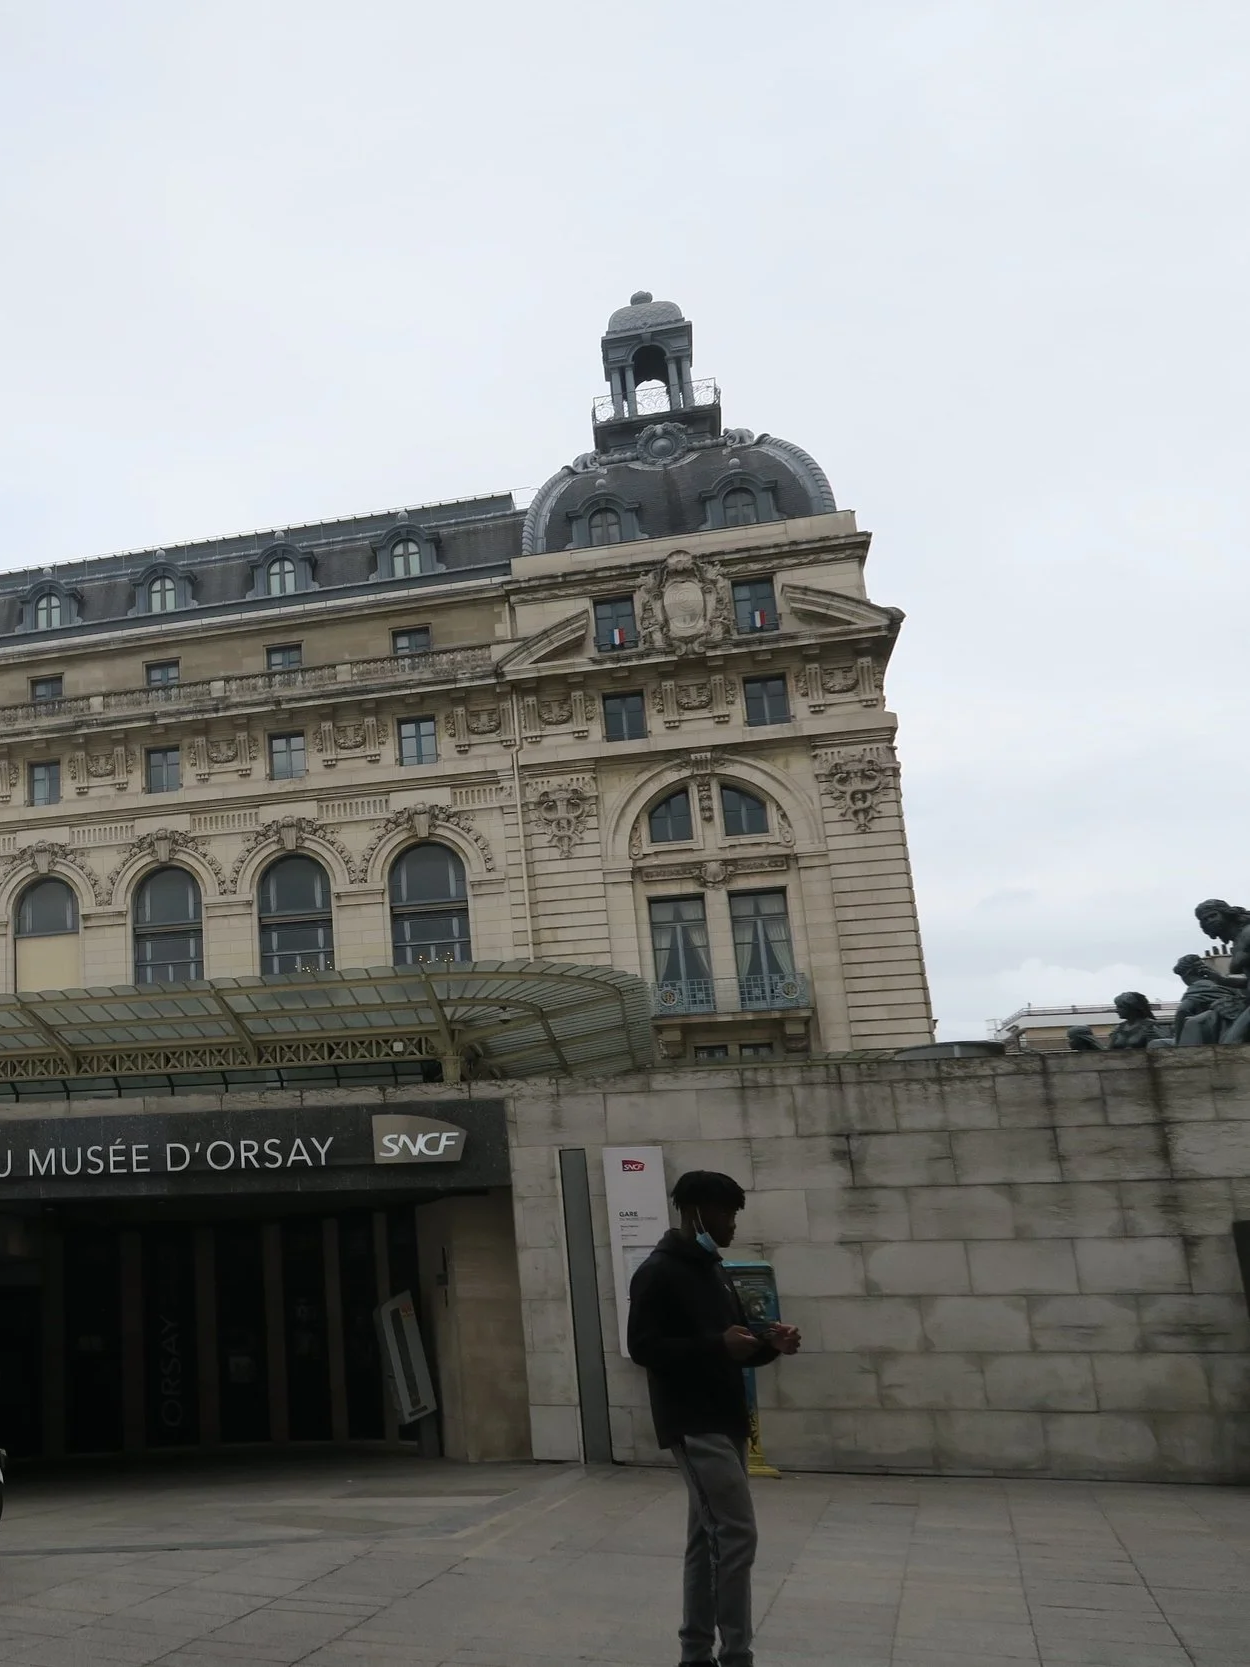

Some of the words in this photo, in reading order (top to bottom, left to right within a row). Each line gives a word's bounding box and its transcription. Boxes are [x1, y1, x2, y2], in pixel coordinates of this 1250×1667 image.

[28, 1138, 151, 1177] MUSÉE
[166, 1136, 335, 1172] D'ORSAY
[379, 1131, 460, 1158] SNCF
[159, 1314, 182, 1427] ORSAY
